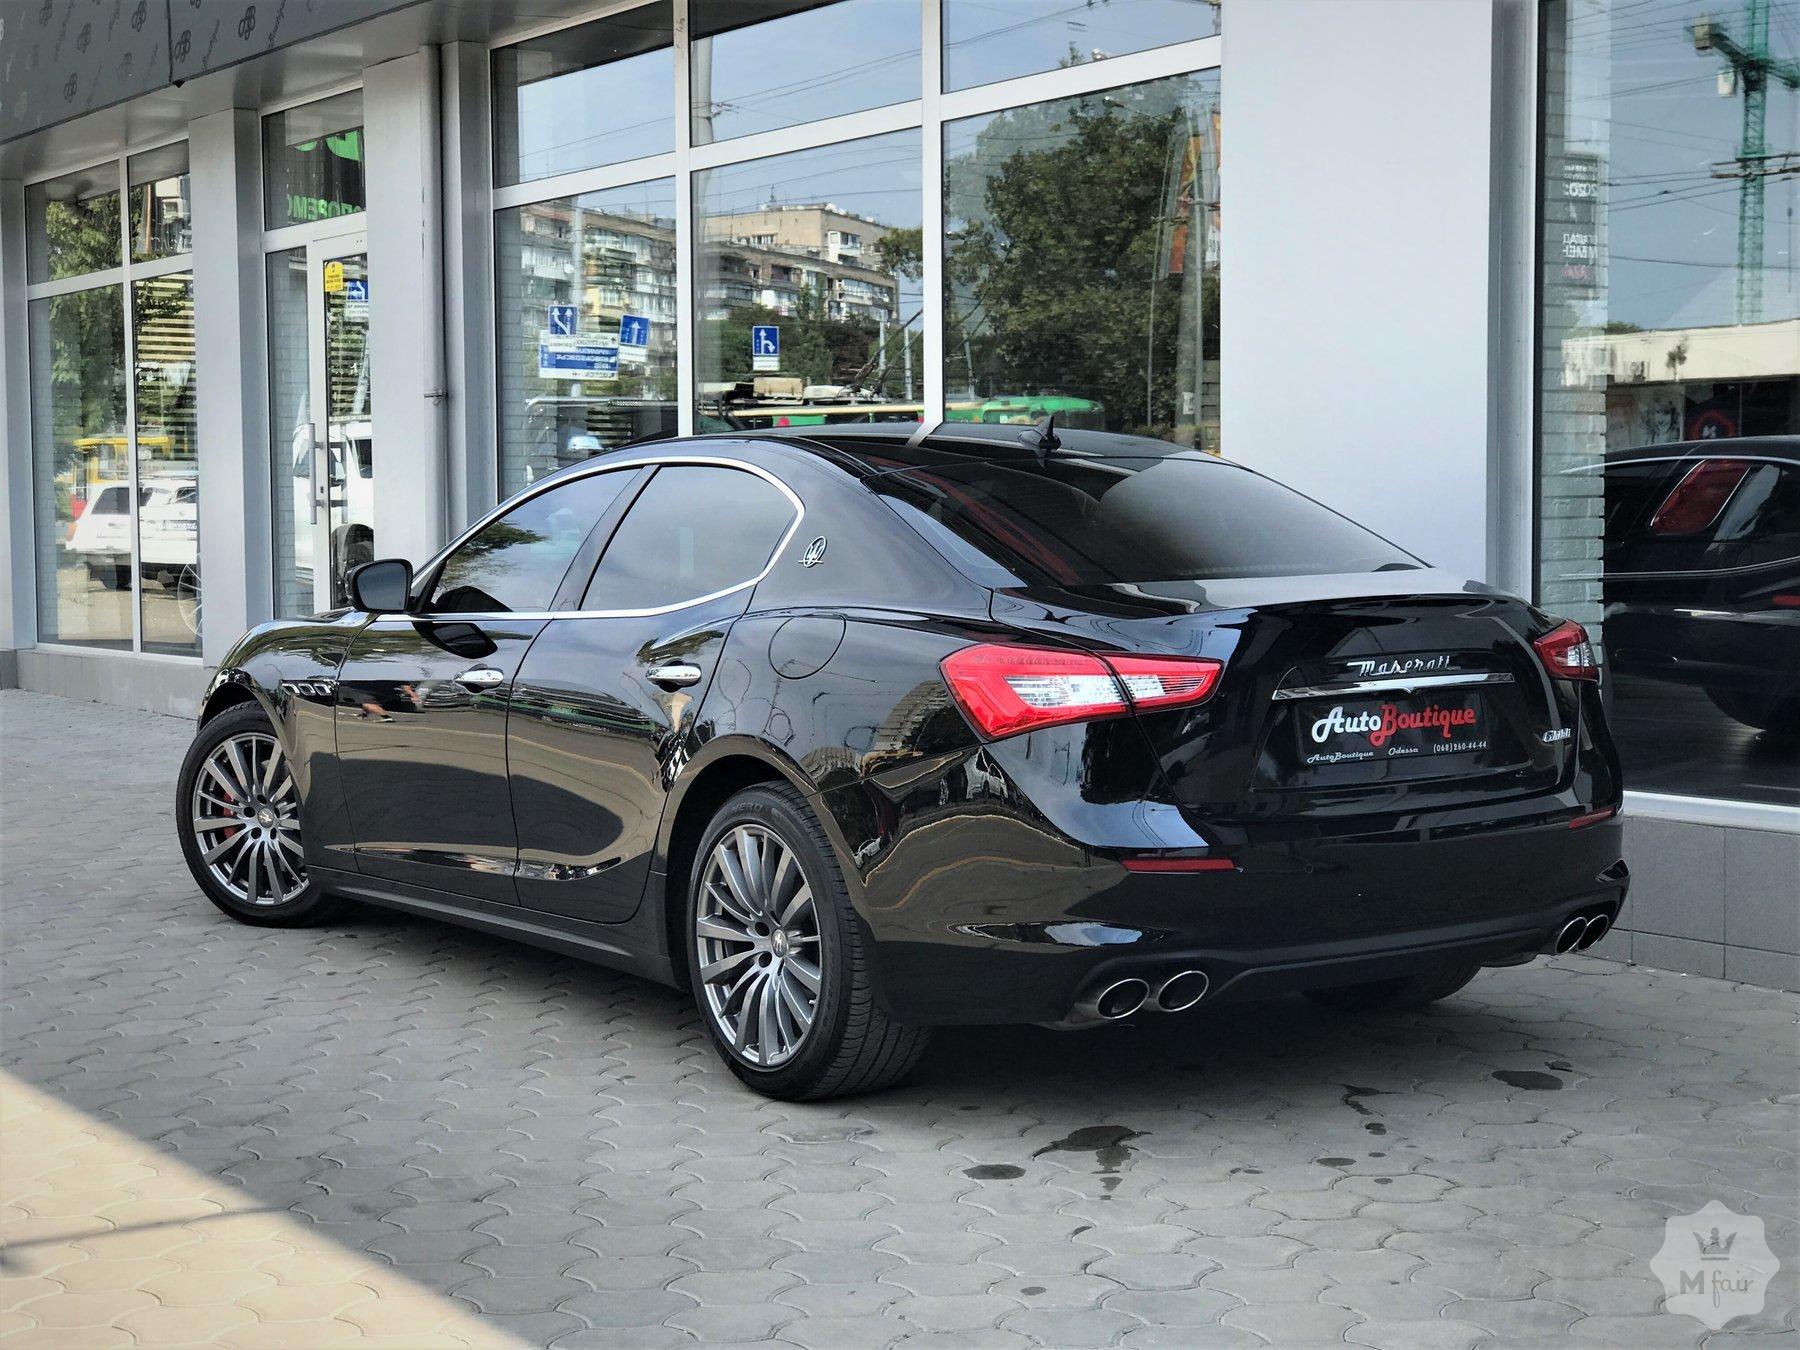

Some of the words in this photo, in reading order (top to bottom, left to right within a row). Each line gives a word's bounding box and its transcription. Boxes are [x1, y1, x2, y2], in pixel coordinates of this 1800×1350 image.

[1347, 655, 1461, 677] Maserati
[1311, 703, 1477, 747] AutoBoutique
[1306, 750, 1374, 763] AutoBoutique
[1388, 746, 1419, 756] Odessa
